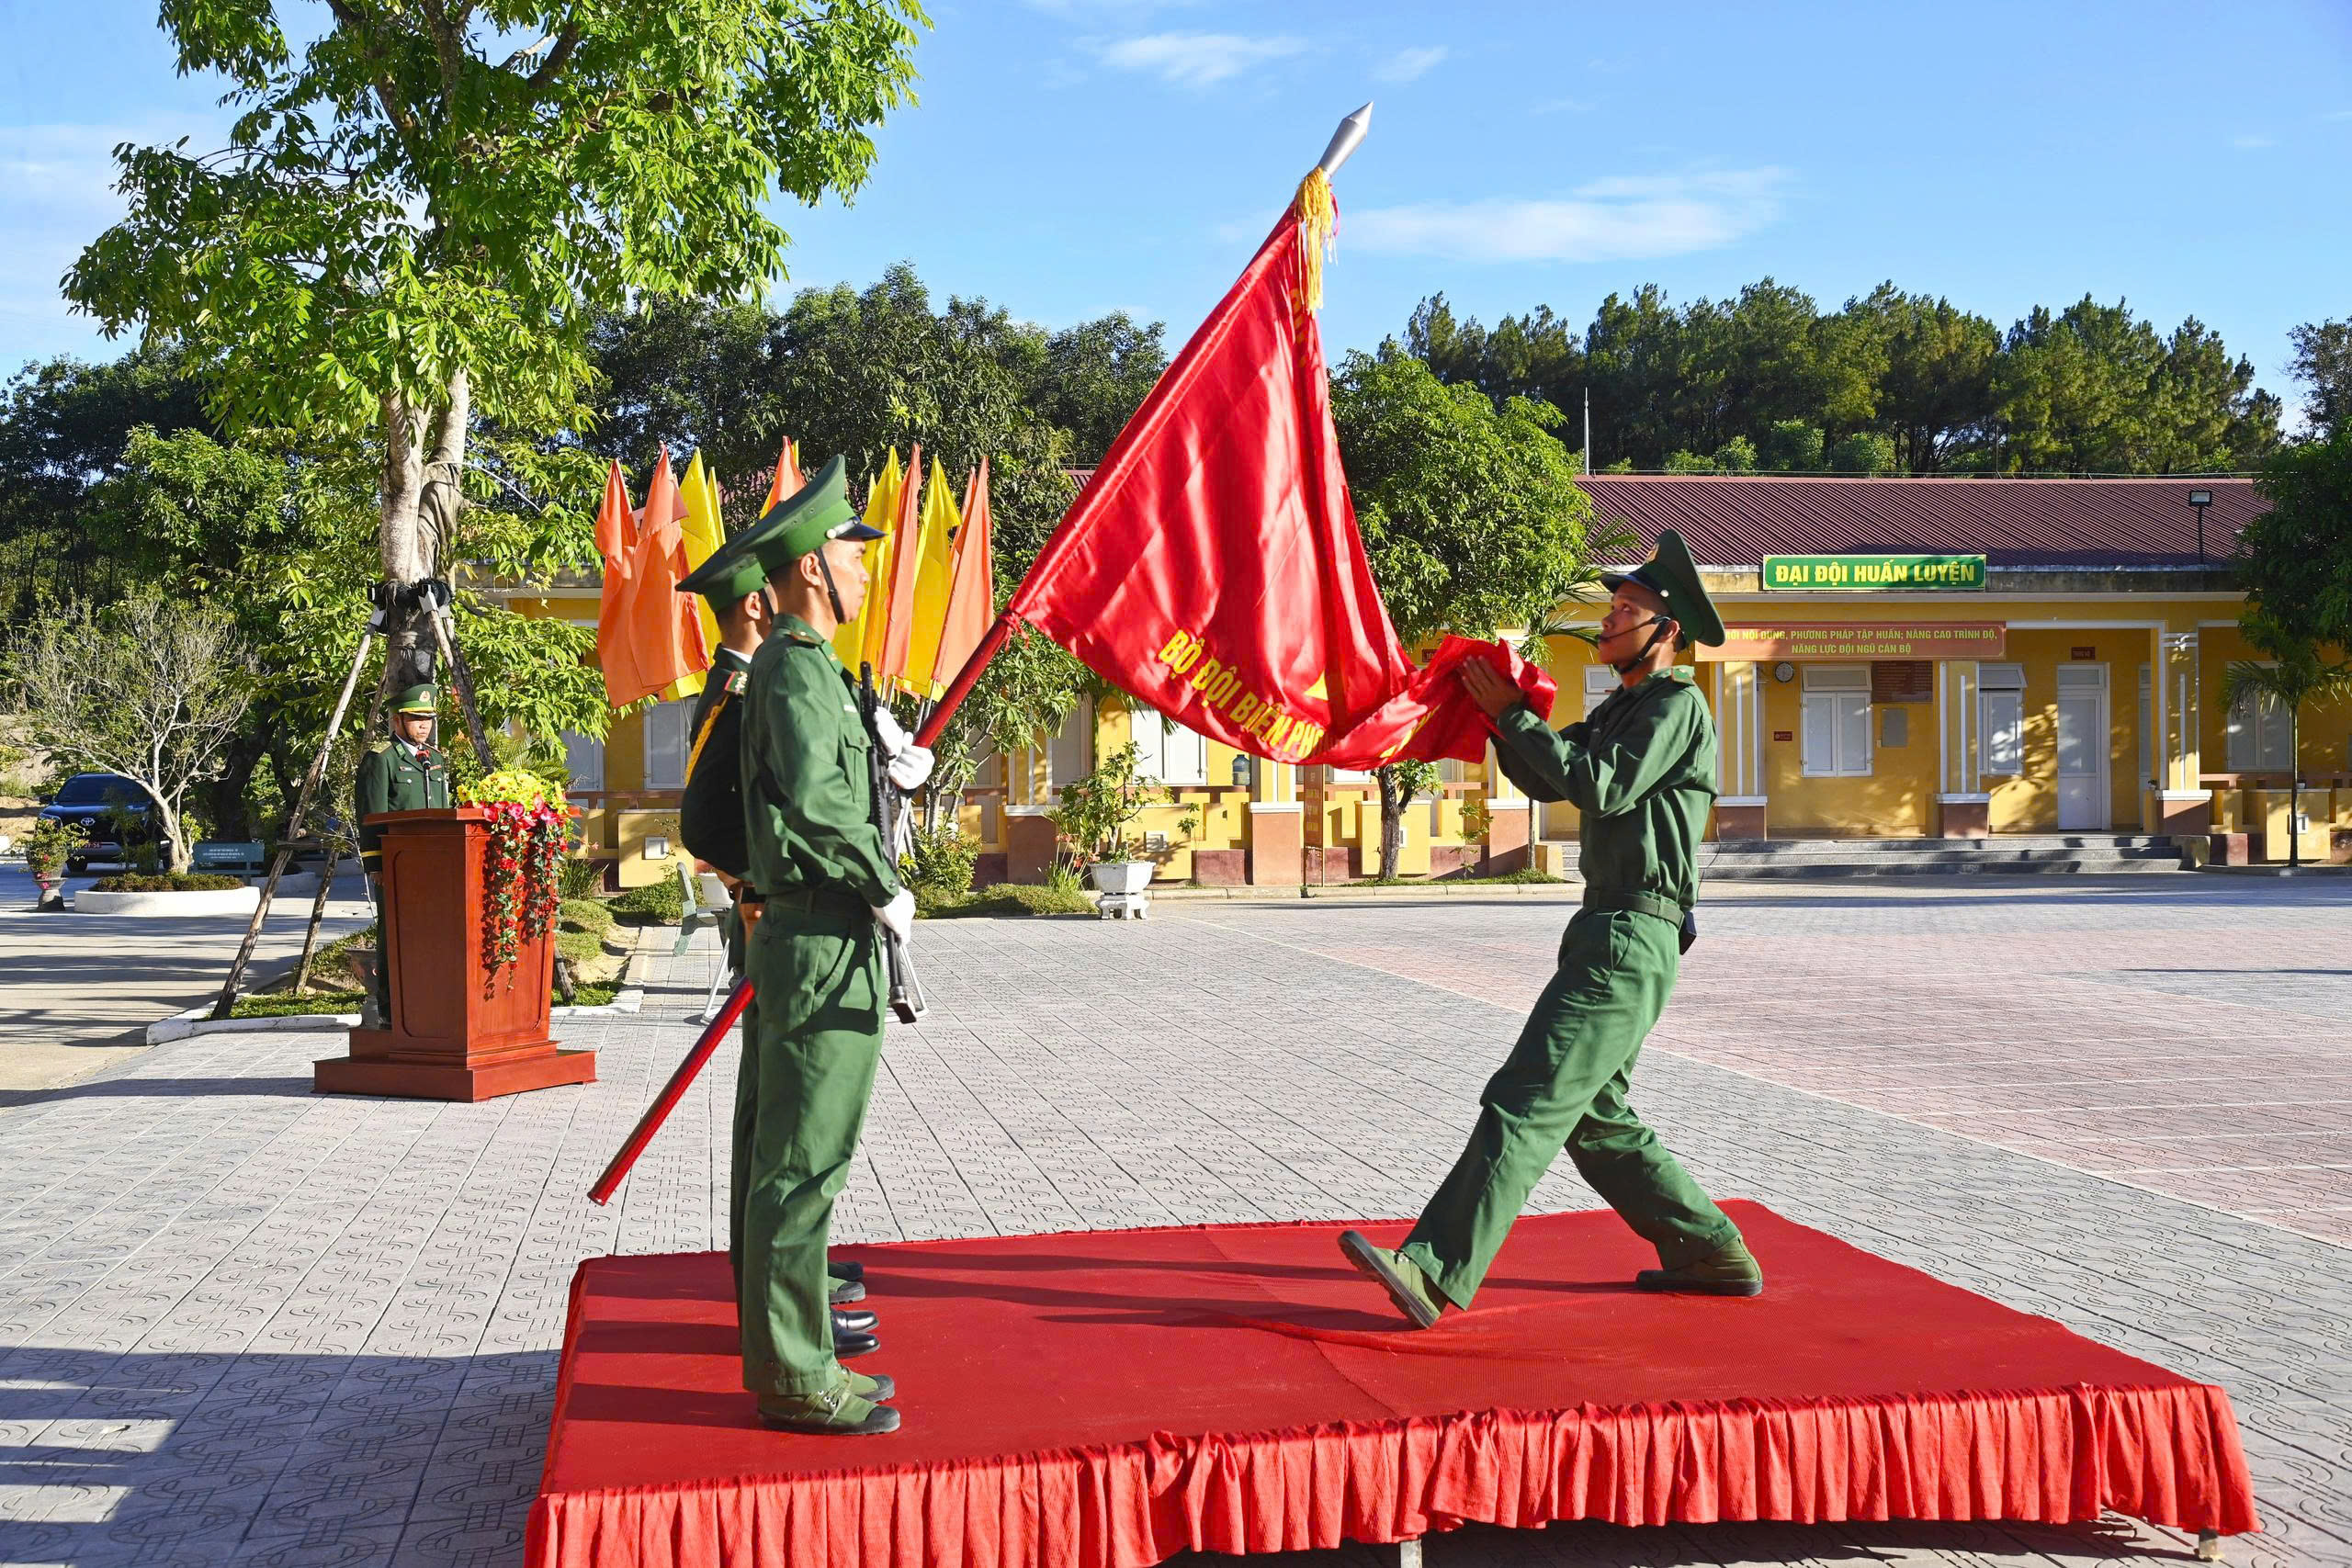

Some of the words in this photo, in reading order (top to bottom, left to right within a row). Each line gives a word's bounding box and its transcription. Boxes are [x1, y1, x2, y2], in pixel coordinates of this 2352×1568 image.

[1775, 565, 1809, 586] ĐẠI
[1815, 561, 1848, 586] ĐỘI
[1853, 558, 1907, 582] HUẤN
[1914, 560, 1974, 585] LUYỆN
[1742, 629, 1758, 642] NỘI
[1791, 629, 1827, 639] PHƯƠNG
[1830, 628, 1853, 639] PHÁP
[1857, 628, 1873, 641] TẬP
[1876, 627, 1903, 640] HUẤN;
[1905, 628, 1931, 639] NÂNG
[1934, 630, 1951, 639] CAO
[1953, 628, 1980, 639] TRÌNH
[1983, 628, 1997, 641] ĐỘ,
[1820, 643, 1837, 656] LỰC
[1838, 642, 1854, 656] ĐỘI
[1857, 642, 1875, 654] NGŨ
[1878, 642, 1897, 654] CÁN
[1899, 642, 1912, 655] BỘ
[1159, 629, 1205, 680] BỘ
[1190, 658, 1242, 709] ĐỘI
[1228, 691, 1294, 747] BIÊN
